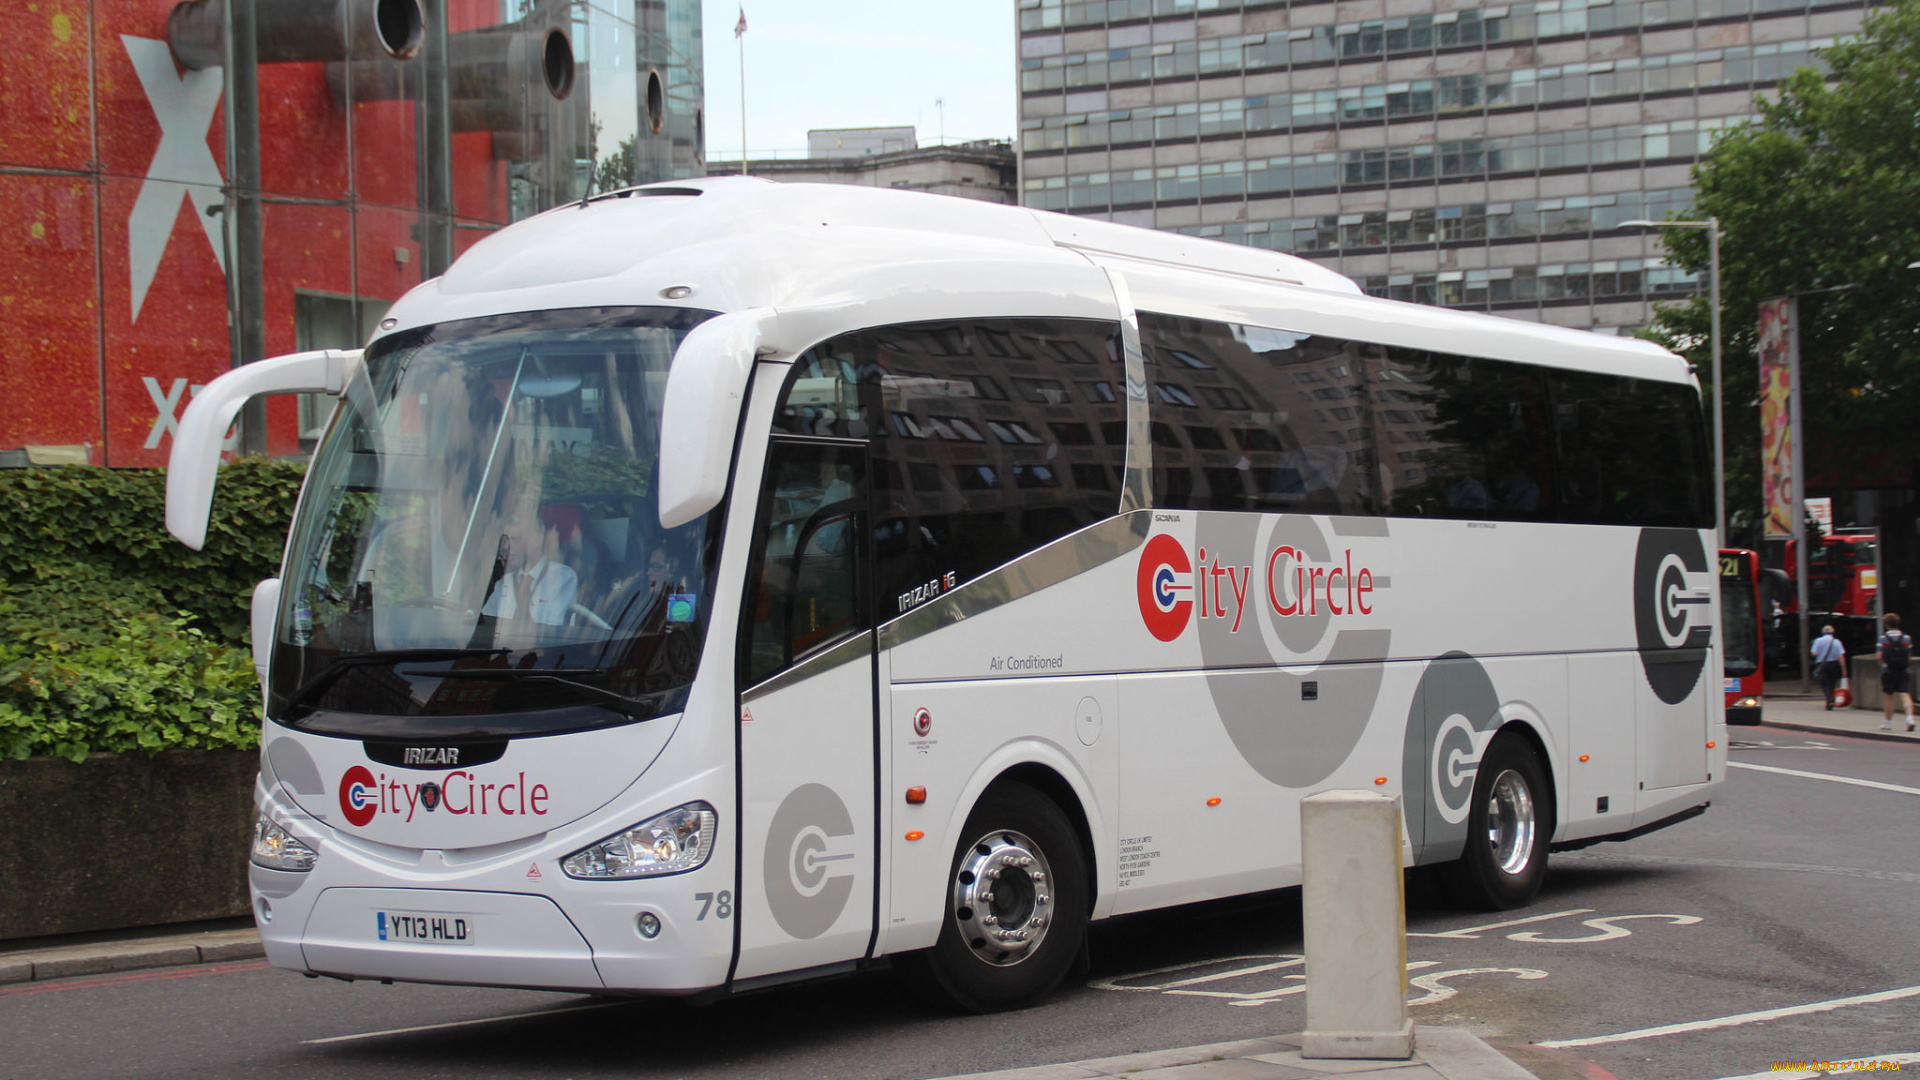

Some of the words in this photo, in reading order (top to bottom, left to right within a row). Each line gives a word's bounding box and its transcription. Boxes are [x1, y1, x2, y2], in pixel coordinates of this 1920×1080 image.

[1155, 514, 1180, 522] SCANIA
[898, 579, 940, 612] IRIZAR
[1137, 533, 1251, 642] City
[1267, 544, 1374, 617] Circle
[989, 656, 1004, 670] Air
[1007, 653, 1063, 670] Conditioned
[404, 747, 460, 764] IRIZAR
[339, 765, 421, 827] City
[442, 771, 549, 815] Circle
[695, 890, 732, 921] 78
[391, 916, 427, 938] YT13
[432, 918, 466, 940] HLD
